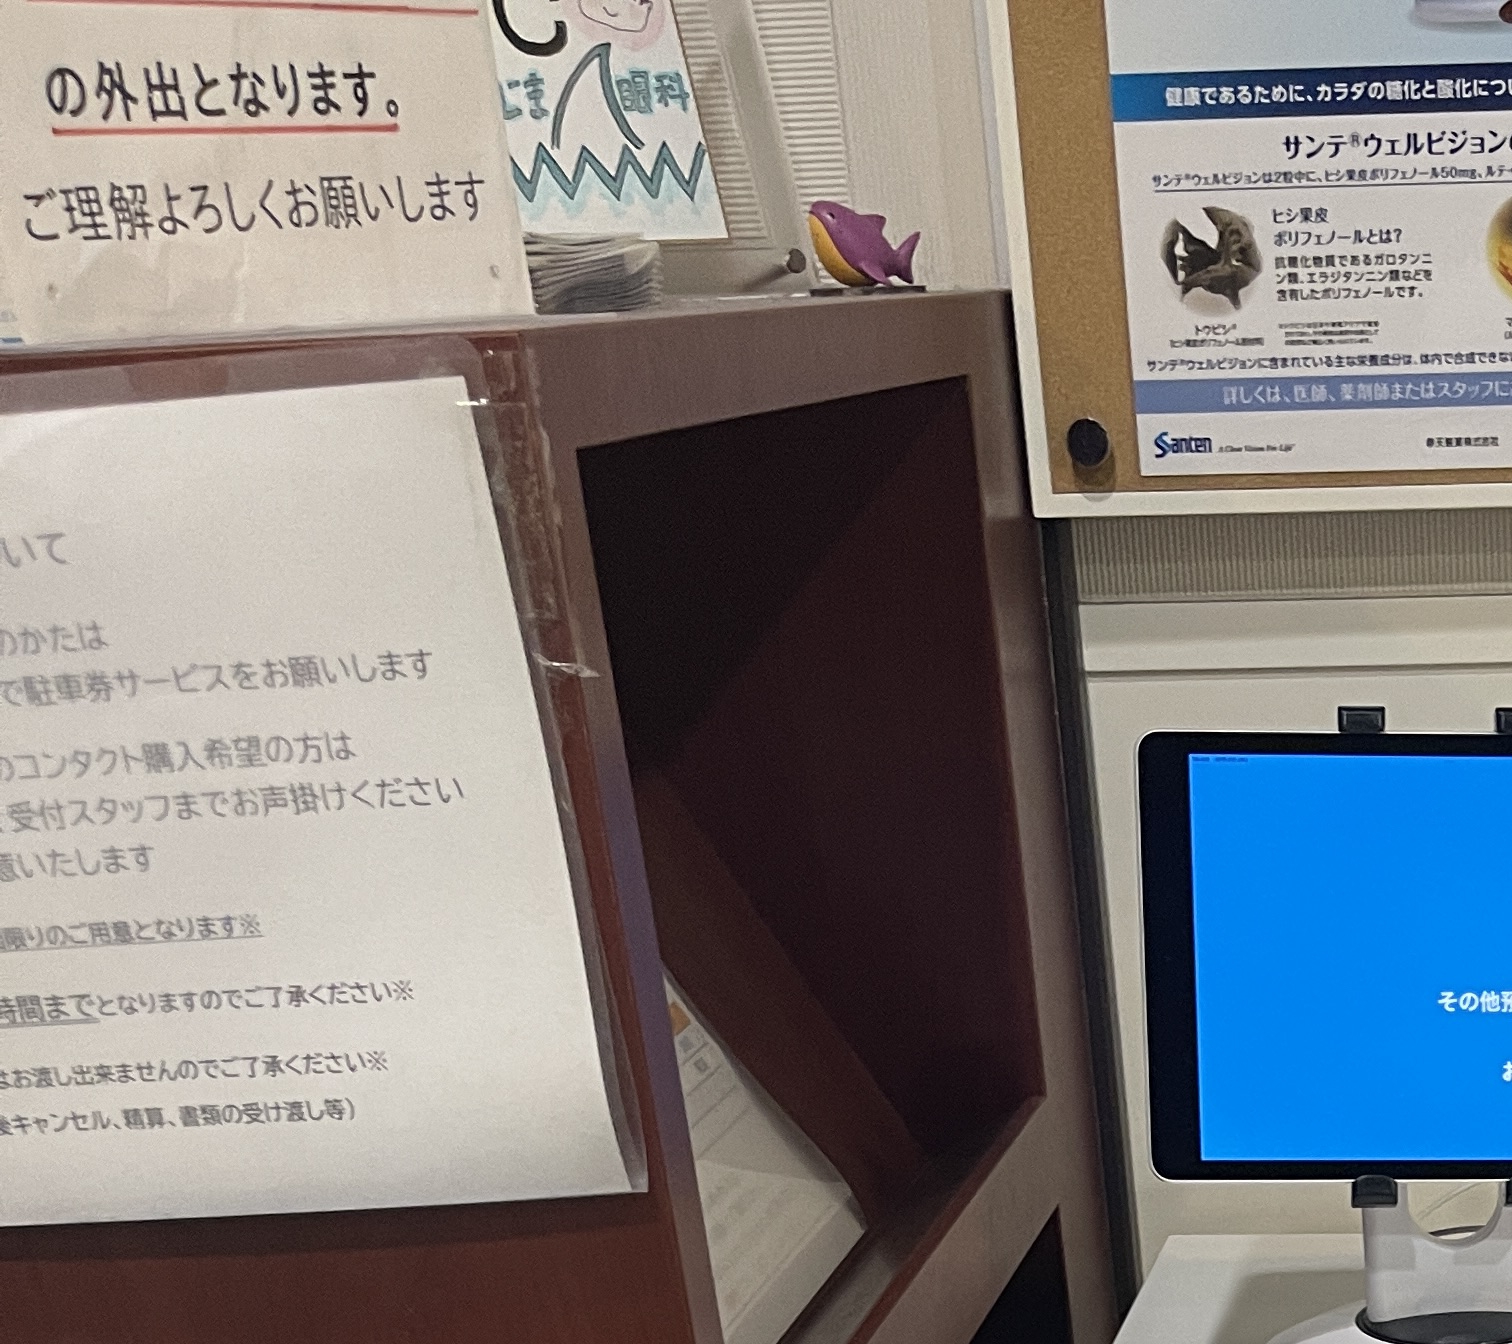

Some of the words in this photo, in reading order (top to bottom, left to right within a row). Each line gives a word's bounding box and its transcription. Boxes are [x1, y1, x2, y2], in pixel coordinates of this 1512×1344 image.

[45, 60, 399, 121] の外出となります。
[23, 171, 485, 241] ご理解よろしくお願いします
[1154, 431, 1213, 458] Santen
[0, 777, 464, 834] 受付スタッフまでお声掛けください
